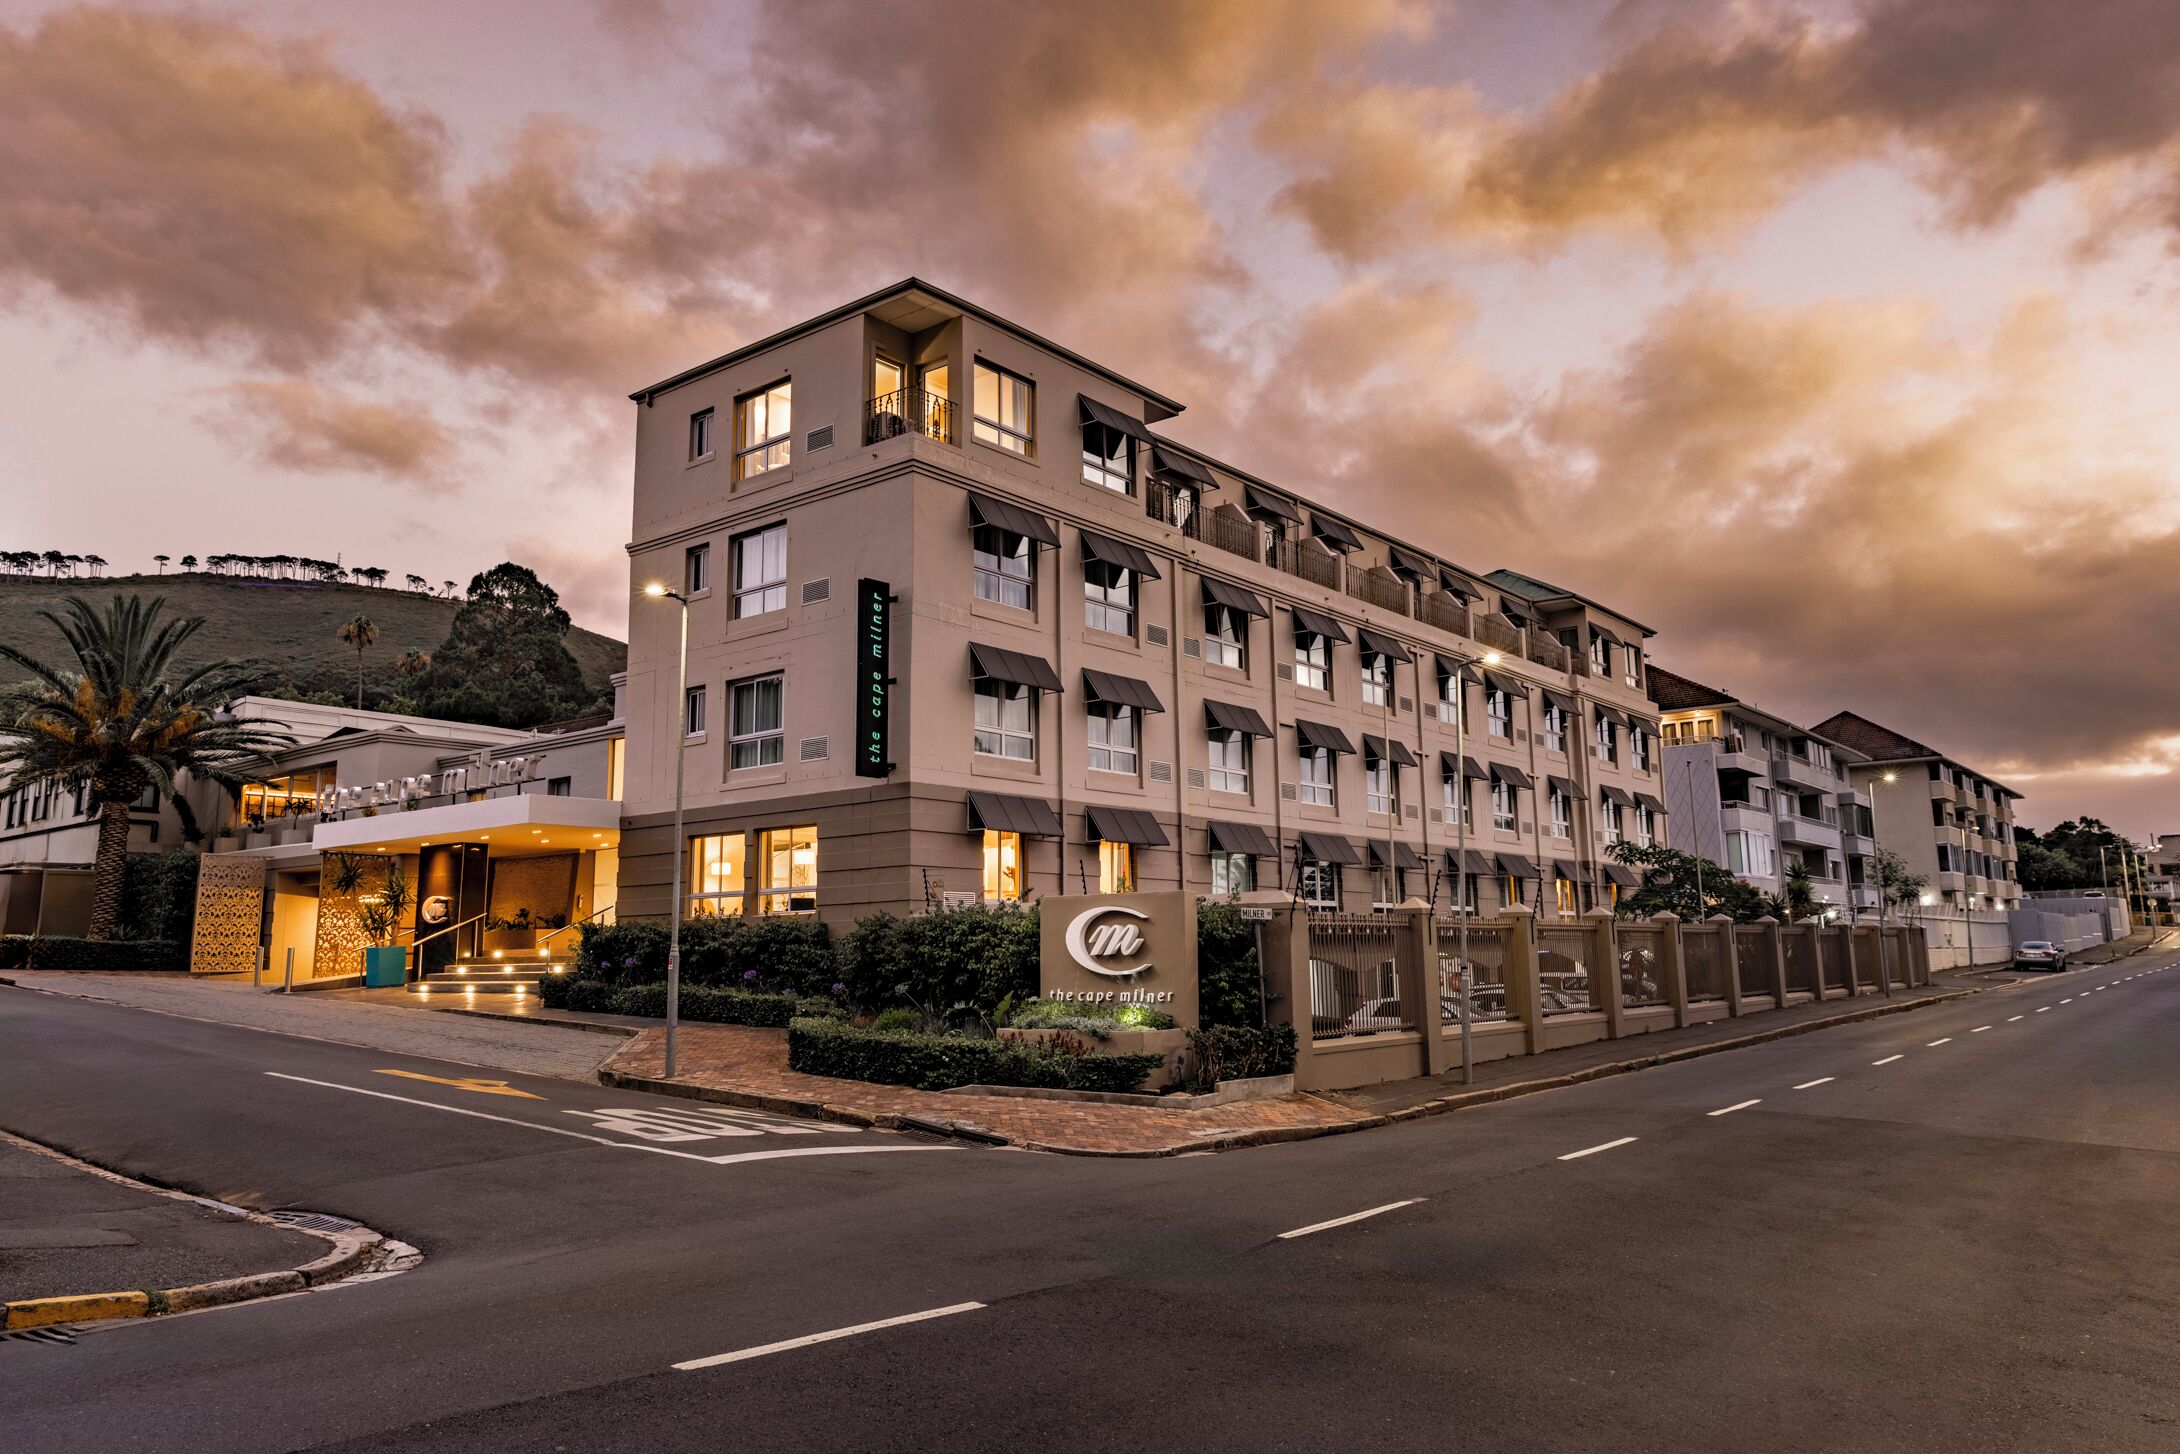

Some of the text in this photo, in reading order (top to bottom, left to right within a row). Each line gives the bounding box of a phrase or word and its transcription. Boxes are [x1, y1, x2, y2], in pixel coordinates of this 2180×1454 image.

[869, 592, 884, 763] the cape milner
[371, 773, 432, 812] cape
[442, 751, 542, 795] milner
[1242, 909, 1265, 919] MILNER
[1049, 987, 1174, 1005] the cape milner
